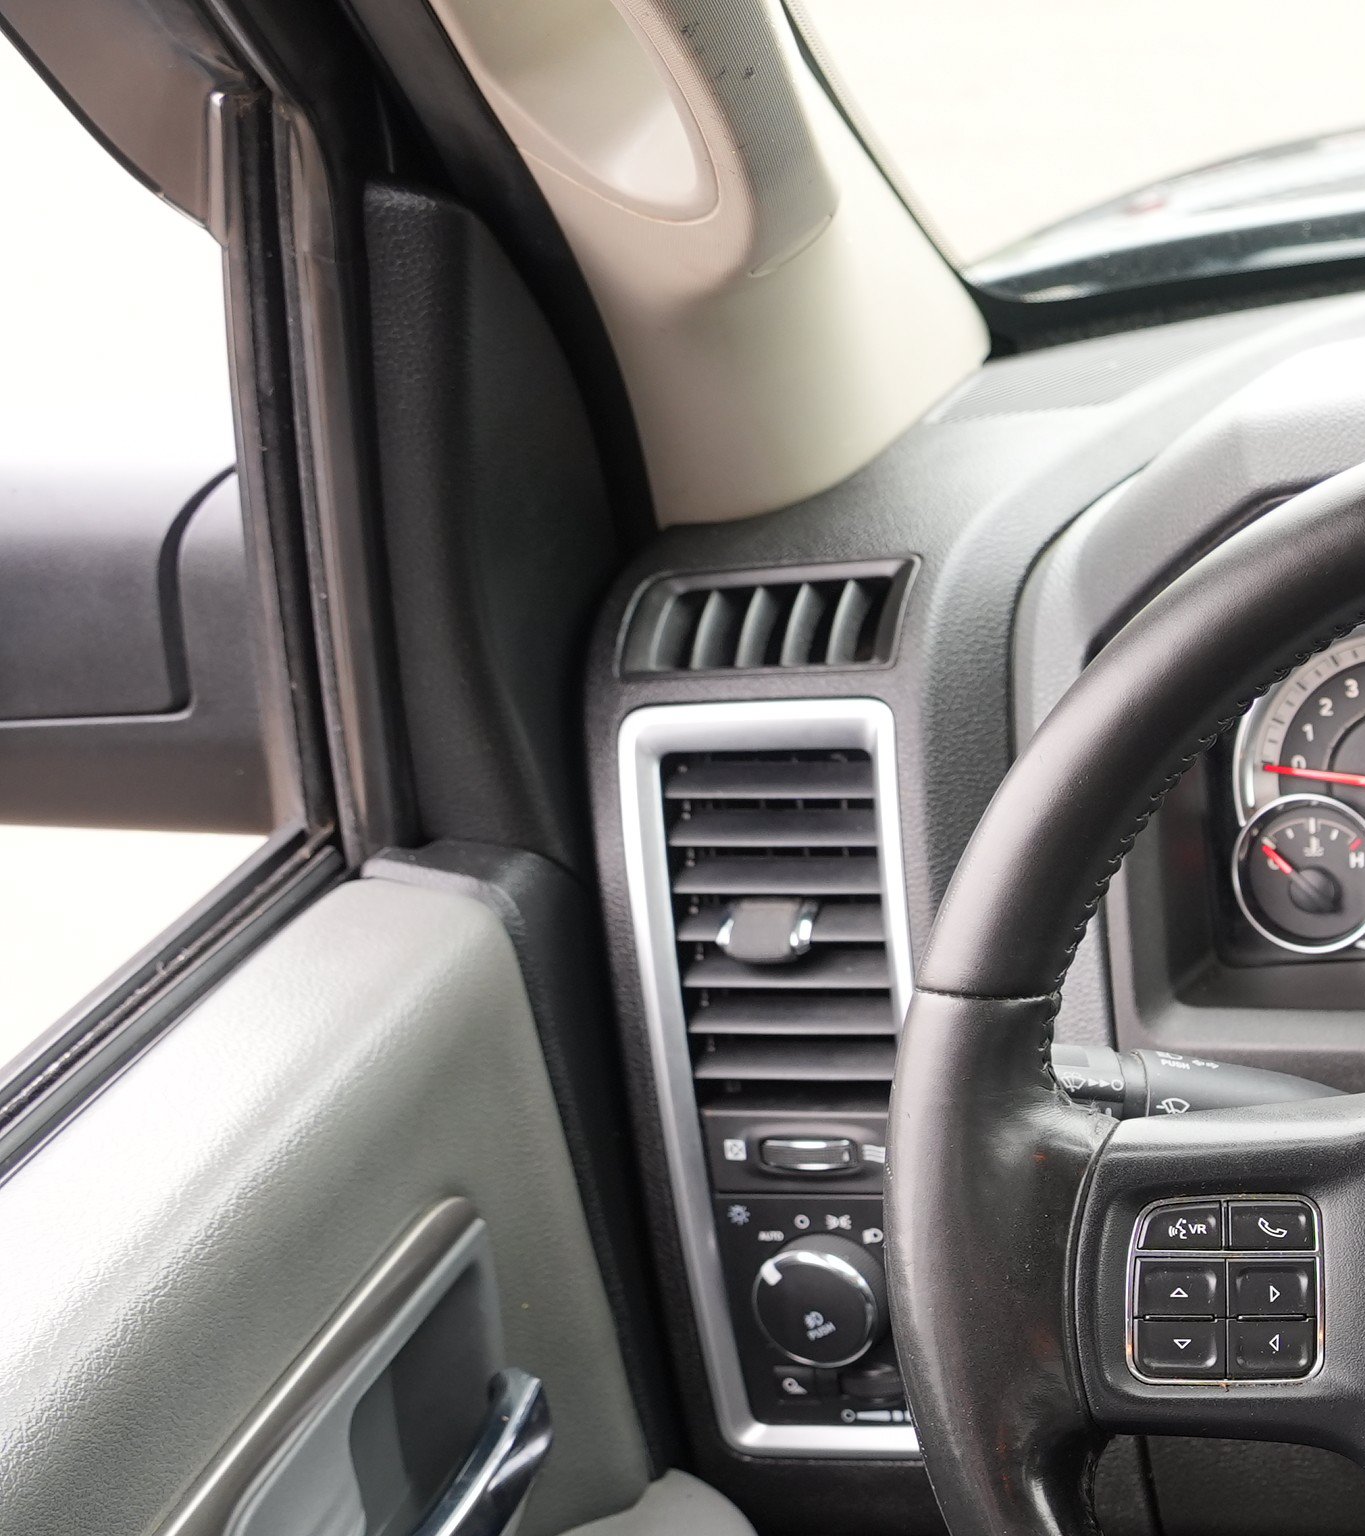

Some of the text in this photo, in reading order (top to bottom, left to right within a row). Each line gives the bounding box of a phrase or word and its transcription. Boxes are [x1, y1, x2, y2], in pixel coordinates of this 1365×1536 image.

[1344, 678, 1360, 698] 3
[1319, 697, 1334, 717] 2
[1302, 723, 1314, 742] 1
[1349, 852, 1365, 869] H
[1188, 1224, 1207, 1234] VR
